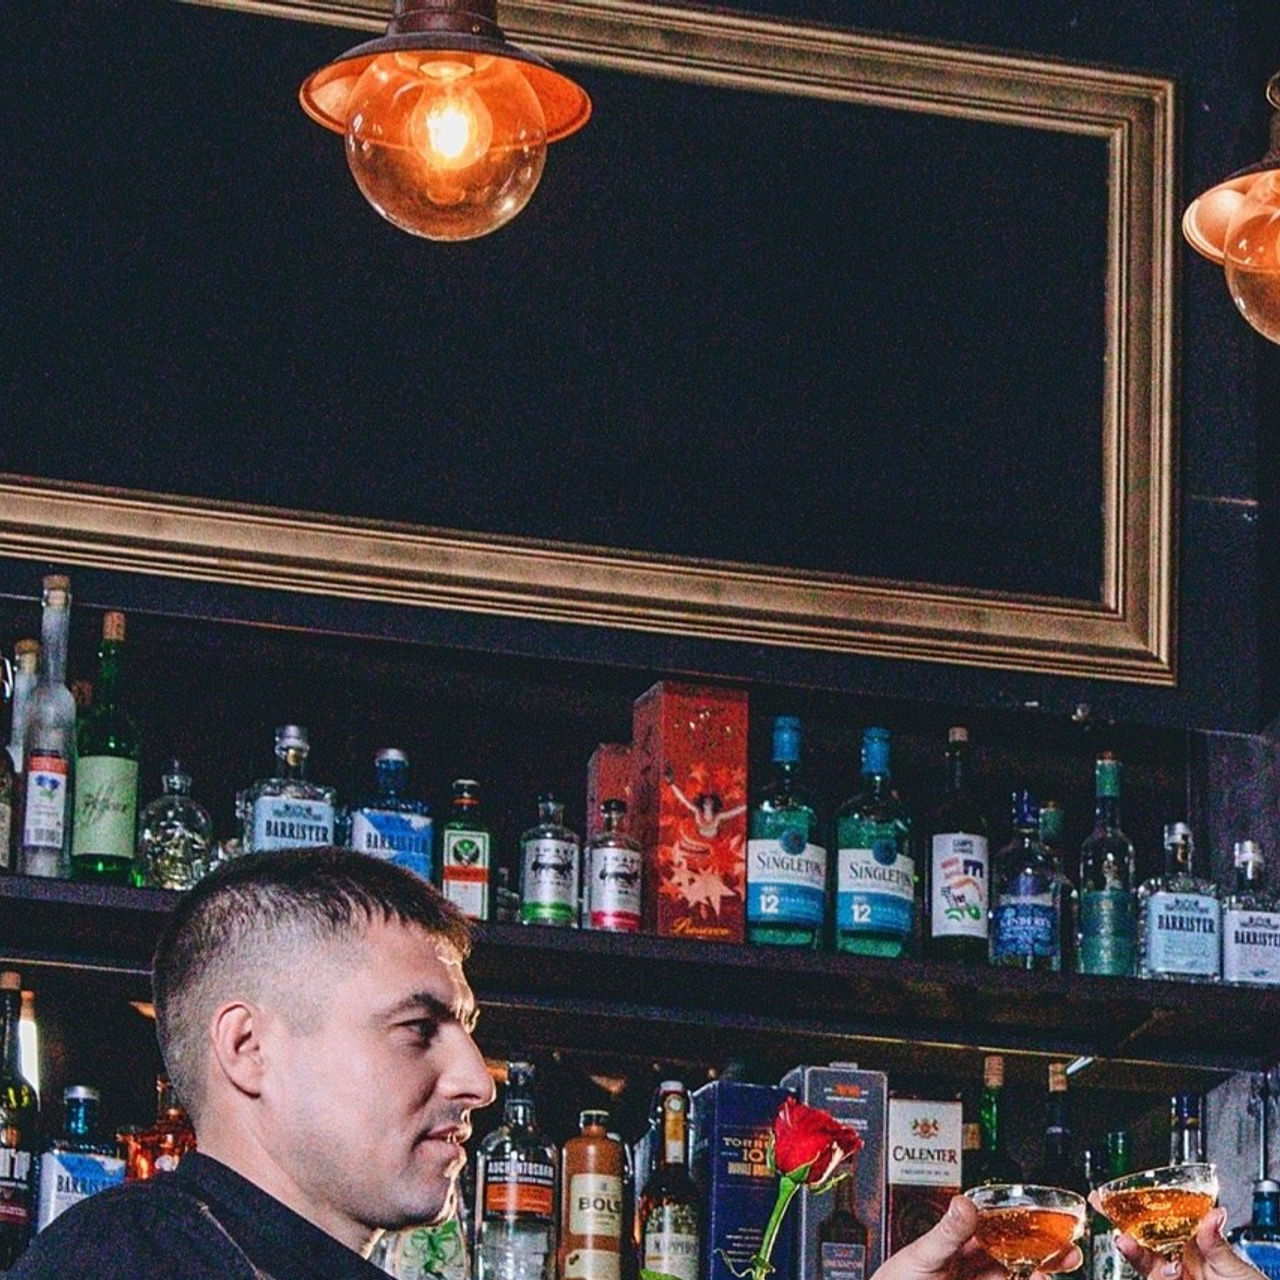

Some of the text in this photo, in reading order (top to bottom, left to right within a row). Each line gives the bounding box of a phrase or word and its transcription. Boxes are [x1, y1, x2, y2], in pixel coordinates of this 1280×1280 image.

[266, 820, 328, 843] BARRISTER
[757, 853, 825, 878] SINGLETON
[760, 895, 779, 914] 12
[852, 904, 872, 923] 12
[1157, 914, 1216, 934] BARRISTER
[723, 1136, 769, 1150] TORR
[743, 1149, 765, 1163] 10
[893, 1145, 957, 1165] CALENTER
[578, 1196, 623, 1214] BOLS
